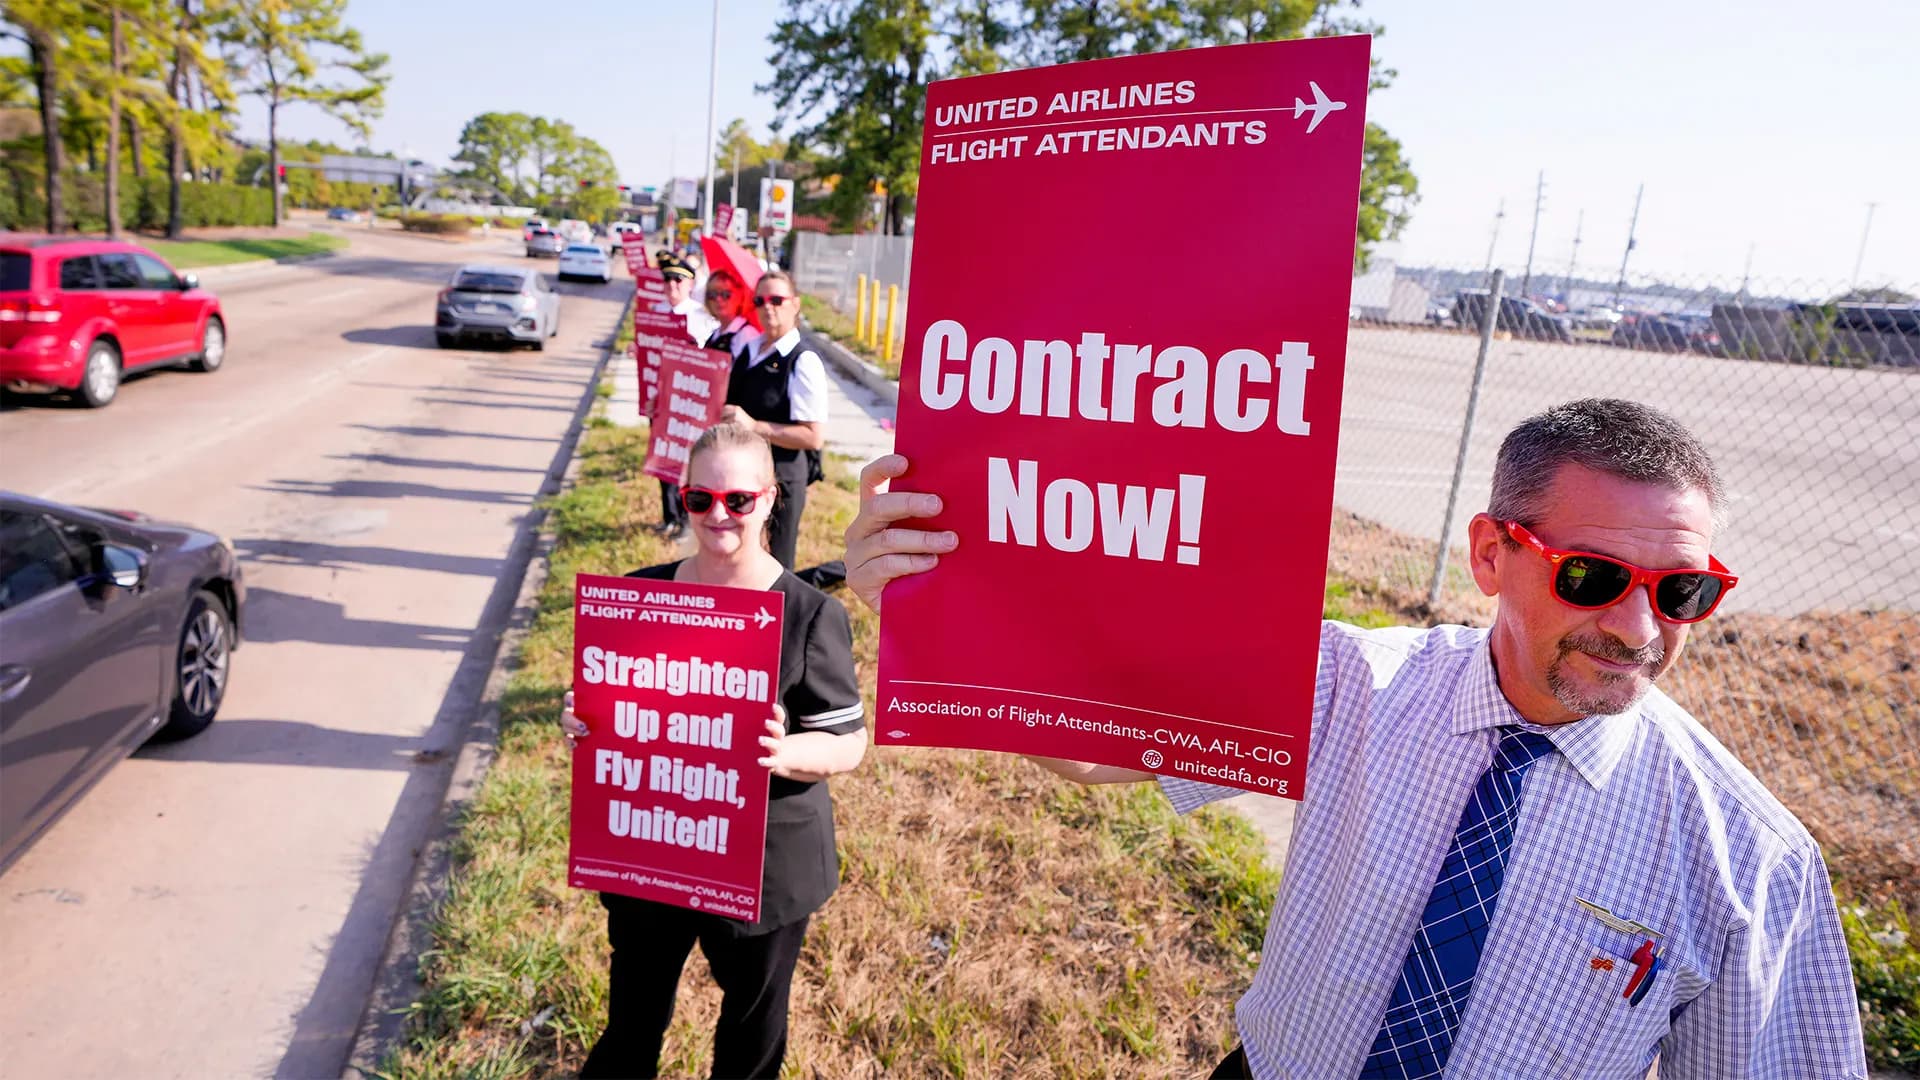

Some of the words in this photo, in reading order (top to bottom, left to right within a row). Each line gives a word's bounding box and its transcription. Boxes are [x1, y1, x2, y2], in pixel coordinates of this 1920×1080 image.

[935, 96, 1038, 127] UNITED
[1046, 80, 1196, 115] AIRLINES
[931, 136, 1028, 164] FLIGHT
[1035, 120, 1267, 156] ATTENDANTS
[919, 319, 1315, 436] Contract
[988, 457, 1207, 566] Now!
[580, 604, 636, 621] FLIGHT
[638, 610, 745, 631] ATTENDANTS
[581, 586, 639, 602] UNITED
[643, 592, 715, 609] AIRLINES
[582, 645, 769, 703] Straighten
[614, 700, 660, 743] Up
[667, 712, 734, 750] and
[887, 697, 981, 718] Association
[987, 704, 1005, 720] of
[1010, 705, 1053, 727] Flight
[595, 748, 643, 791] Fly
[649, 755, 746, 809] Right,
[1174, 759, 1289, 795] unitedafa.org
[608, 800, 730, 855] United!
